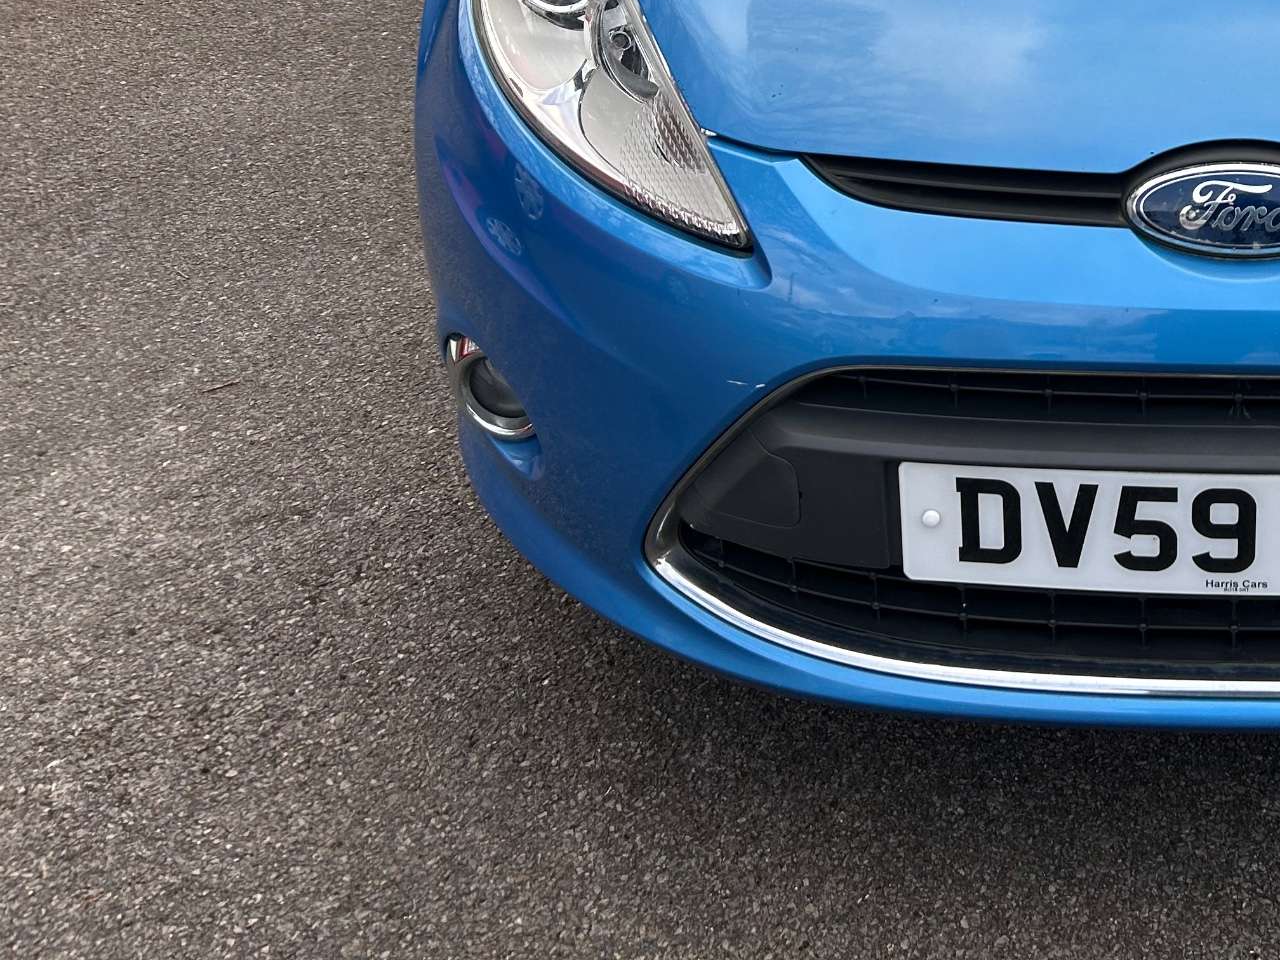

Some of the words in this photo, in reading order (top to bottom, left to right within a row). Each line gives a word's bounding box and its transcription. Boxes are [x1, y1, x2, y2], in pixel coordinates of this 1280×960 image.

[956, 477, 1257, 573] DV59
[1205, 579, 1239, 588] Harris
[1242, 579, 1268, 589] Cars
